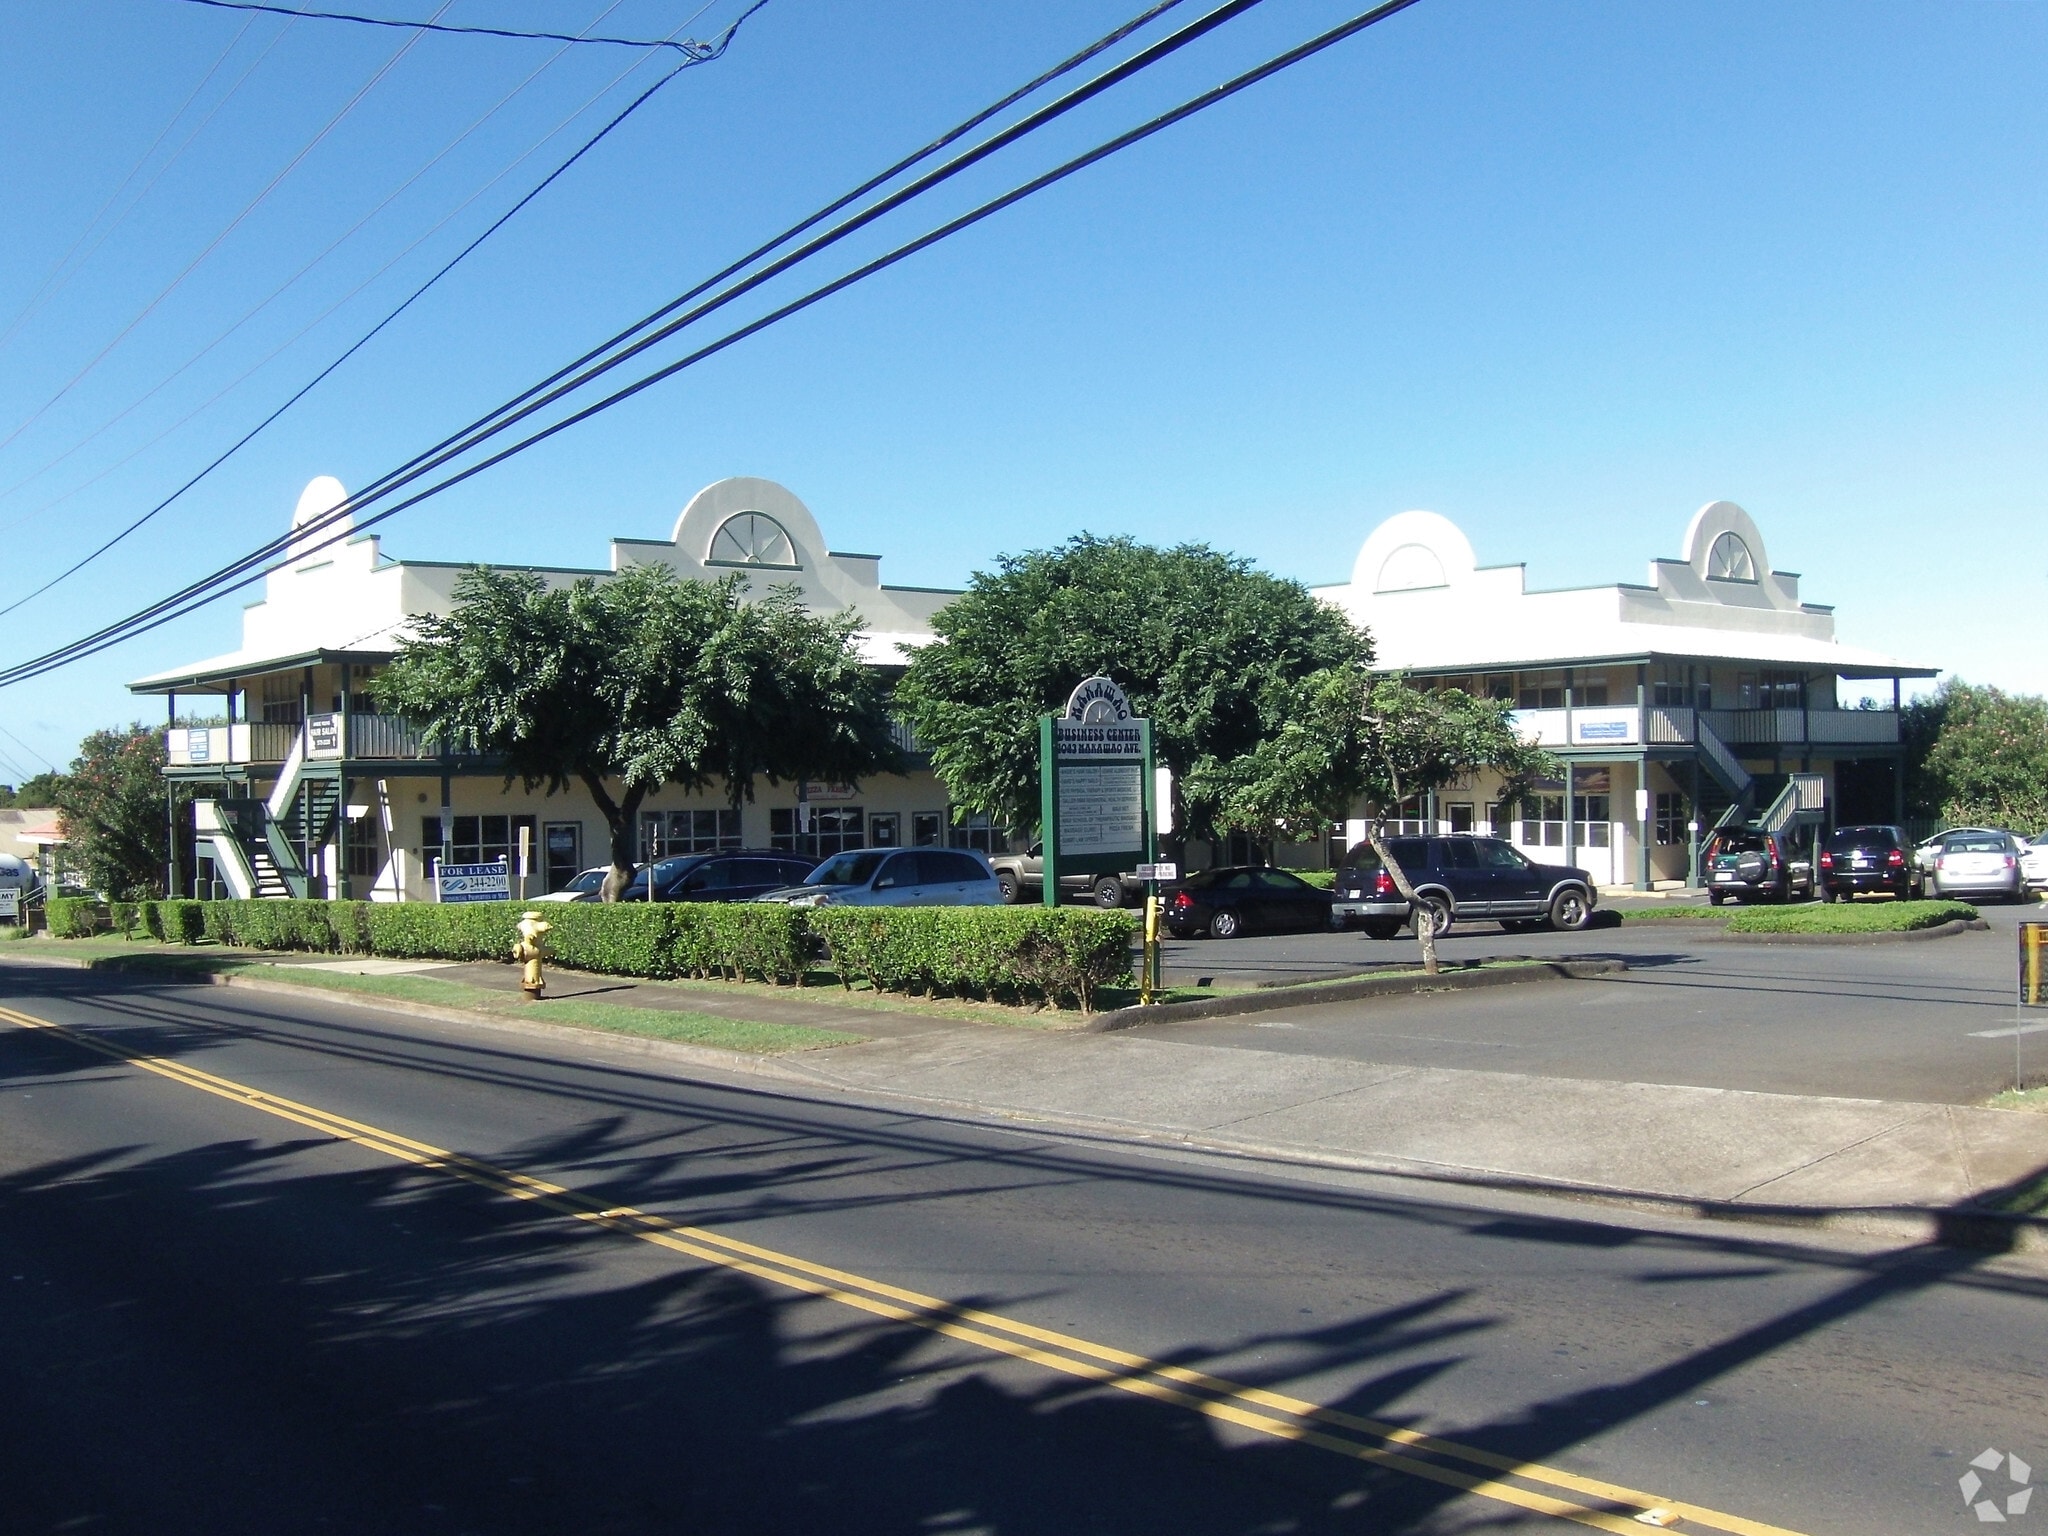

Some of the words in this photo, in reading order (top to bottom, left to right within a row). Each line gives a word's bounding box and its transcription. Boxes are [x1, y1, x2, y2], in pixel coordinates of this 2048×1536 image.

[1072, 683, 1128, 720] MAKAWAO
[1058, 728, 1105, 742] BUSINESS
[1106, 728, 1141, 742] CENTER
[1078, 743, 1122, 754] MAKAWAO
[1124, 742, 1141, 754] AVE.
[441, 868, 464, 876] FOR
[469, 866, 505, 874] LEASE
[470, 876, 506, 888] 244-2200
